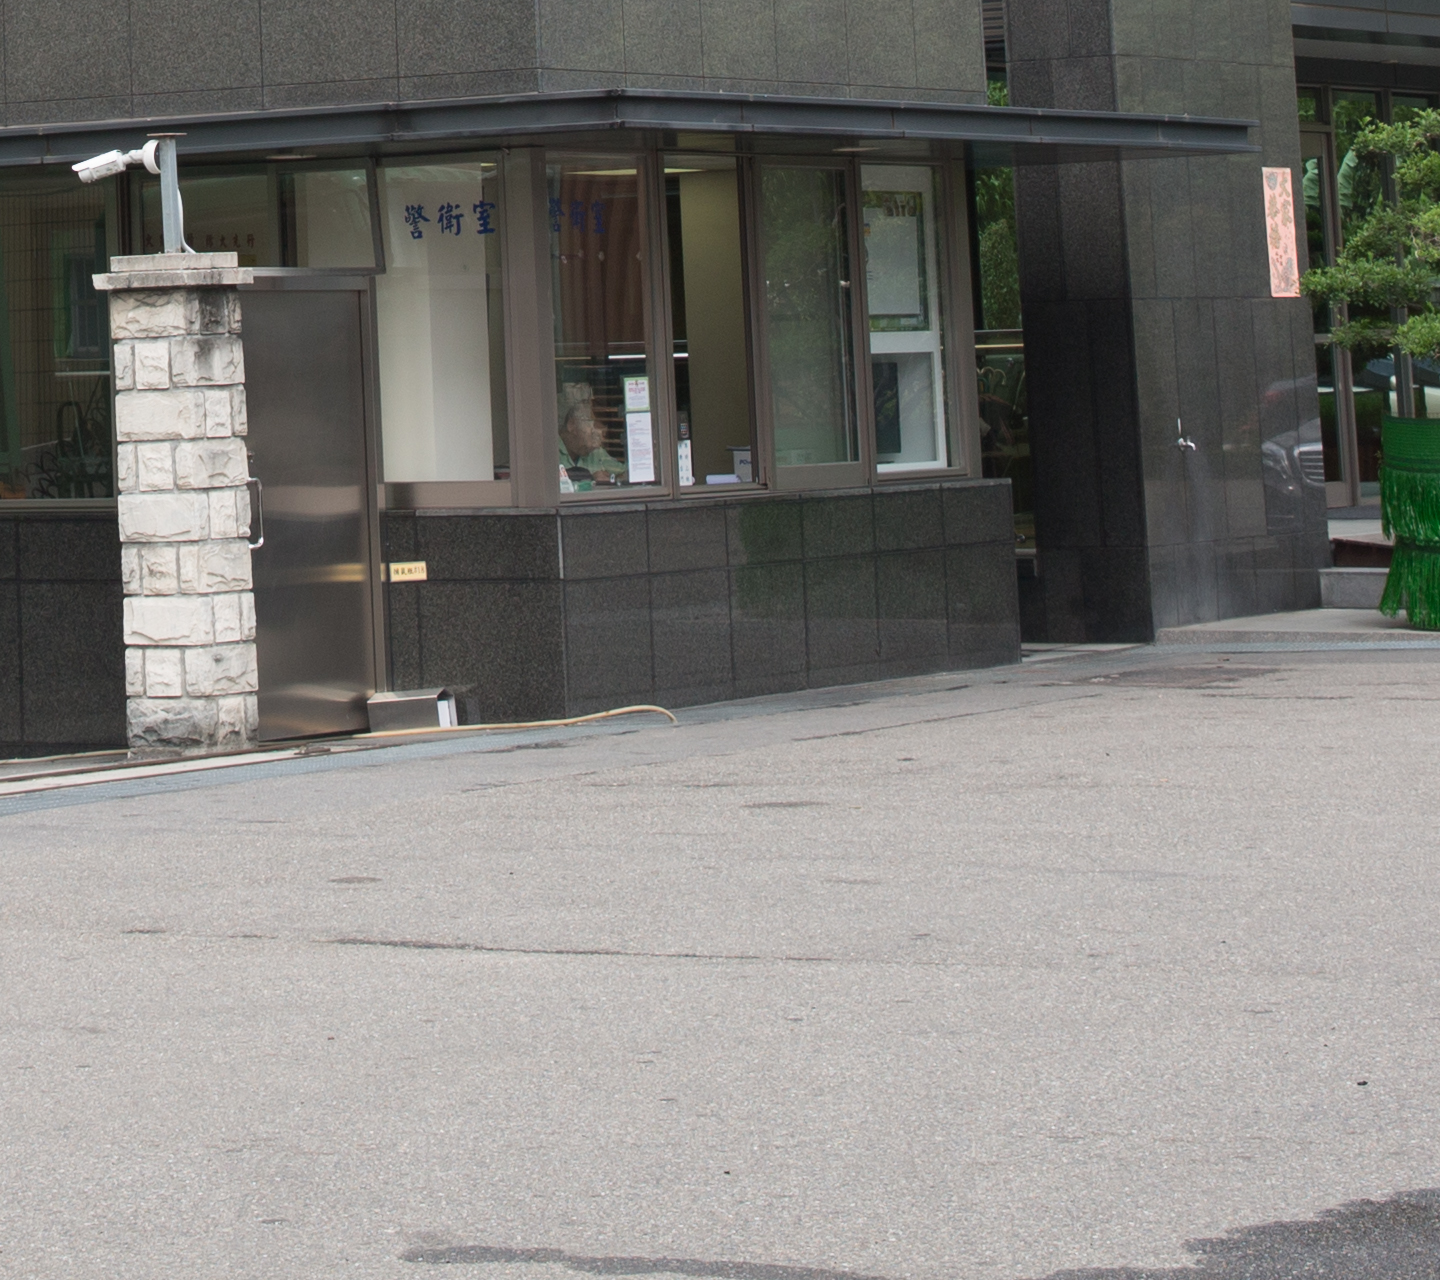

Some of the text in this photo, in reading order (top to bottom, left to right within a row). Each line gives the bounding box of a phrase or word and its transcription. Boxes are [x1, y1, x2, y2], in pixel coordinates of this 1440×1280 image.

[404, 200, 496, 240] 警衛室
[548, 197, 606, 235] 警衛室
